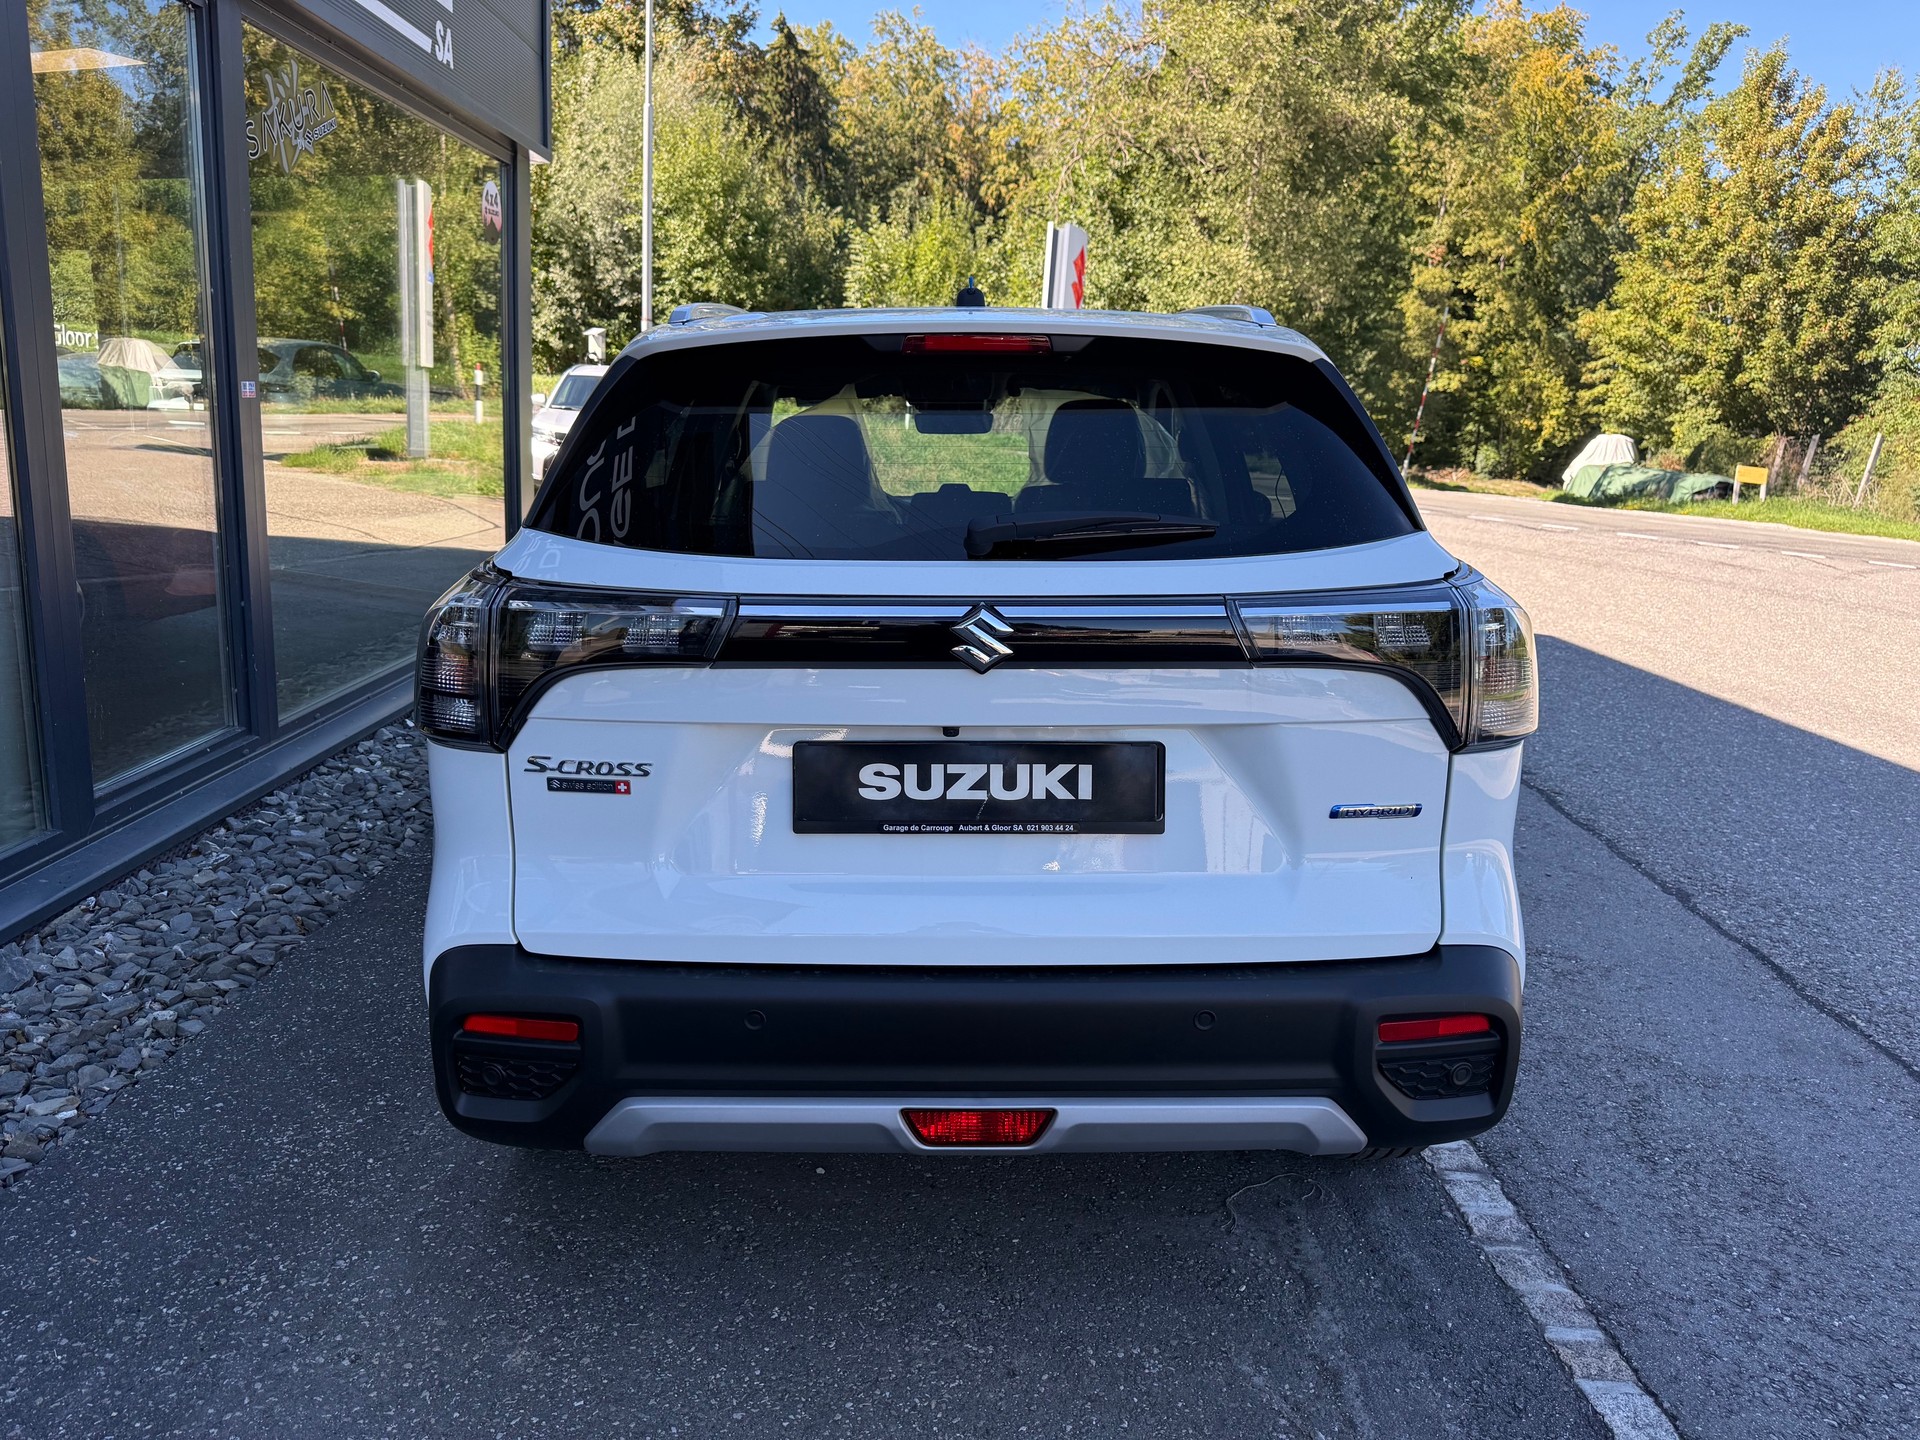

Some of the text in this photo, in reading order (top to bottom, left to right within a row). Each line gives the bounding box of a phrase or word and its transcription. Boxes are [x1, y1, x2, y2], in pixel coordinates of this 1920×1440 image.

[435, 20, 454, 70] SA
[245, 80, 335, 159] SAKURA
[562, 781, 613, 791] swiss edition
[858, 763, 1092, 800] SUZUKI
[1345, 807, 1410, 818] HYBRID
[883, 824, 909, 832] Garage
[920, 824, 954, 832] Carrouge
